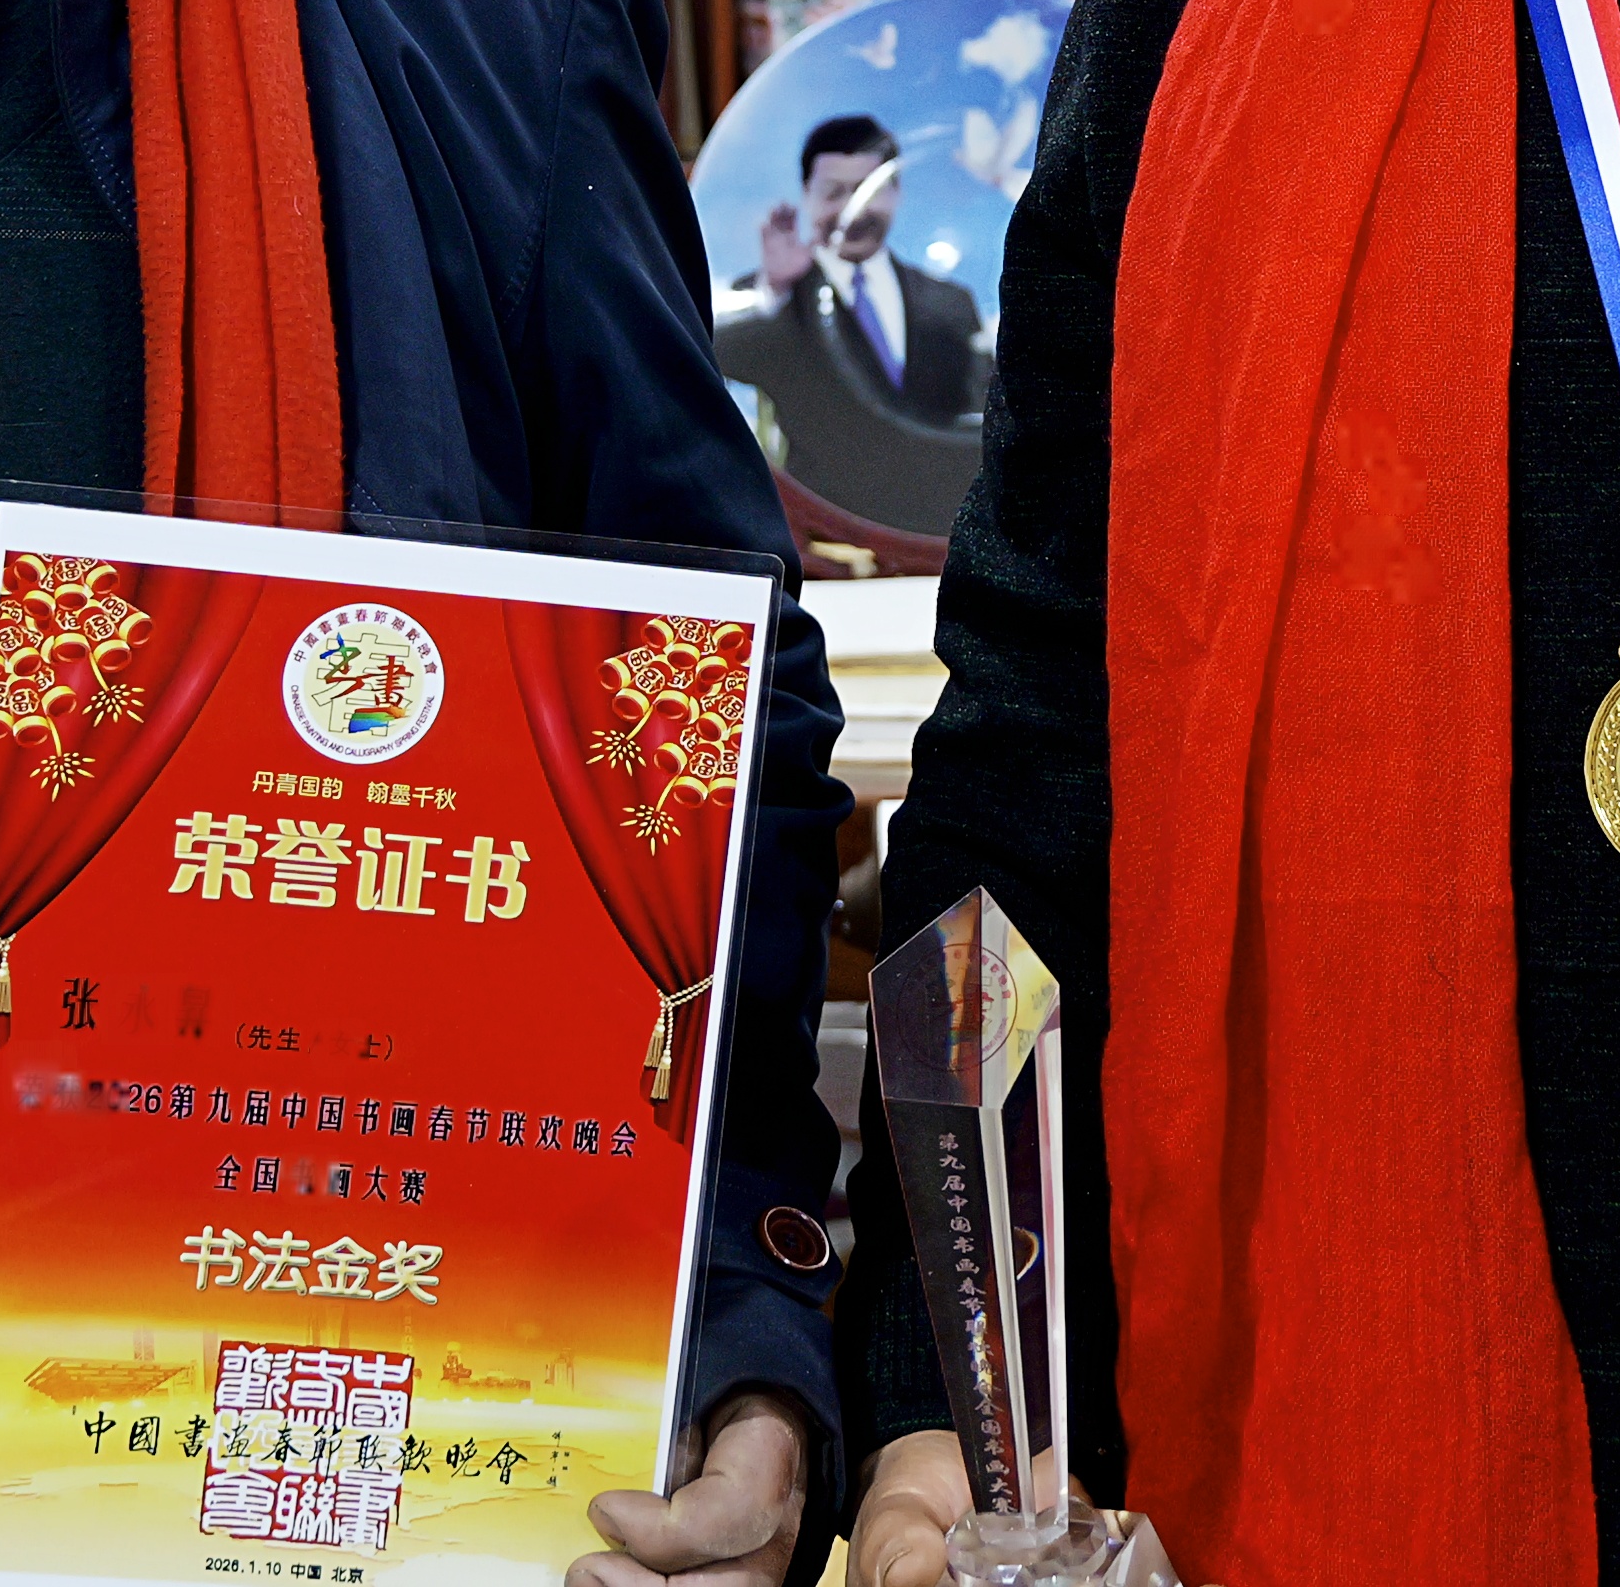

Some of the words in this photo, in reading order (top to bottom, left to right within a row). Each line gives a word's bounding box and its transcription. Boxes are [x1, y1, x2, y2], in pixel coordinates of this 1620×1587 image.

[328, 741, 345, 753] AND
[344, 743, 395, 757] CALLIGRAPHY
[394, 727, 420, 747] SPRING
[415, 695, 436, 728] FESTIVAL
[252, 771, 343, 800] 丹青国韵
[366, 780, 457, 811] 翰墨千秋
[168, 811, 531, 923] 荣誉证书
[235, 1022, 394, 1061] (先生士)
[16, 1073, 638, 1158] 226第九届中国书画春节联欢晚会
[213, 1154, 428, 1205] 全国画大赛
[180, 1225, 444, 1305] 书法金奖
[938, 1132, 1019, 1515] 第九届中国书画春节联欢晚会全国书画大赛
[205, 1558, 282, 1576] 2026.1.10
[290, 1564, 322, 1580] 中国
[331, 1566, 364, 1584] 北京
